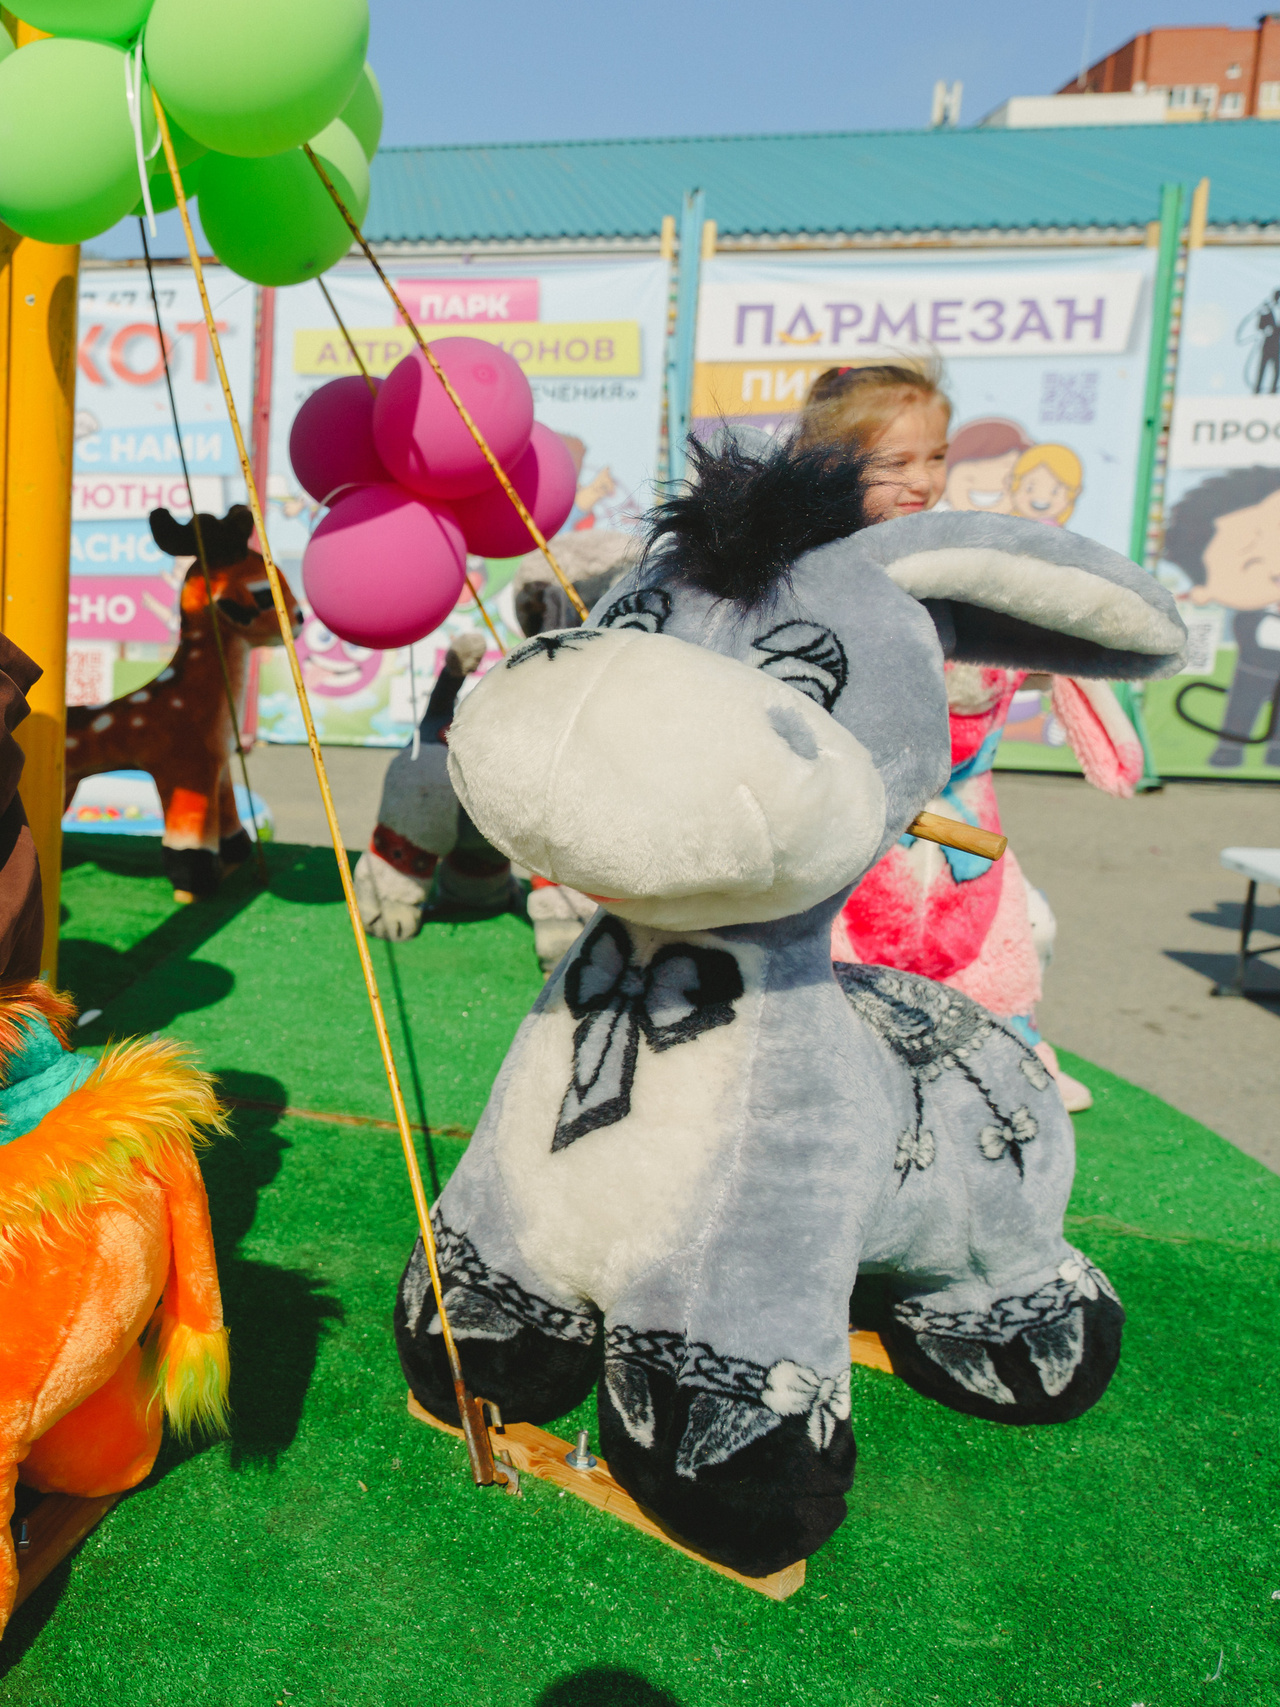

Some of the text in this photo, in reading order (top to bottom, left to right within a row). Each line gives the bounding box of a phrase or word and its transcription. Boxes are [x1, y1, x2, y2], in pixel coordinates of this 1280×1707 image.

[420, 293, 509, 320] ПАРК
[735, 298, 1105, 346] ПАРМЕЗАН
[317, 338, 615, 366] АТТРОНОВ
[742, 369, 819, 402] ПИ
[110, 432, 222, 462] НАМИ
[72, 483, 192, 509] ЮТНО
